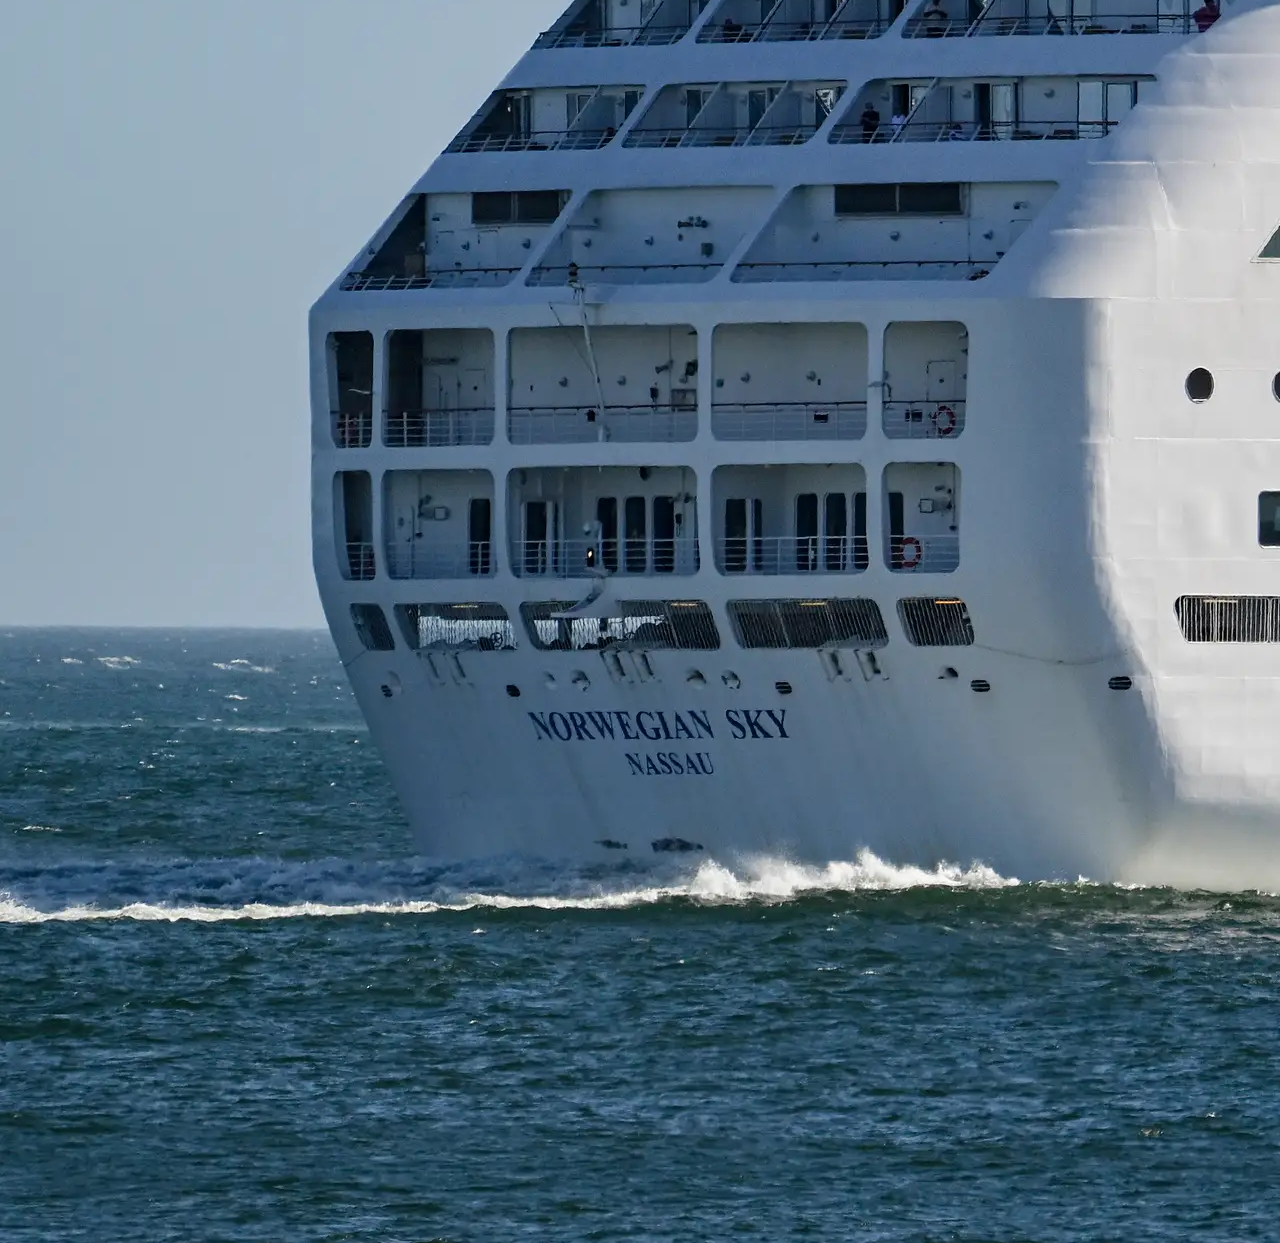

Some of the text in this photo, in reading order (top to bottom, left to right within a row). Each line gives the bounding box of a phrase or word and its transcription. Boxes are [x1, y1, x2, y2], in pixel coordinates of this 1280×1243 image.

[527, 708, 790, 741] NORWEGIAN SKY
[624, 752, 714, 776] NASSAU
